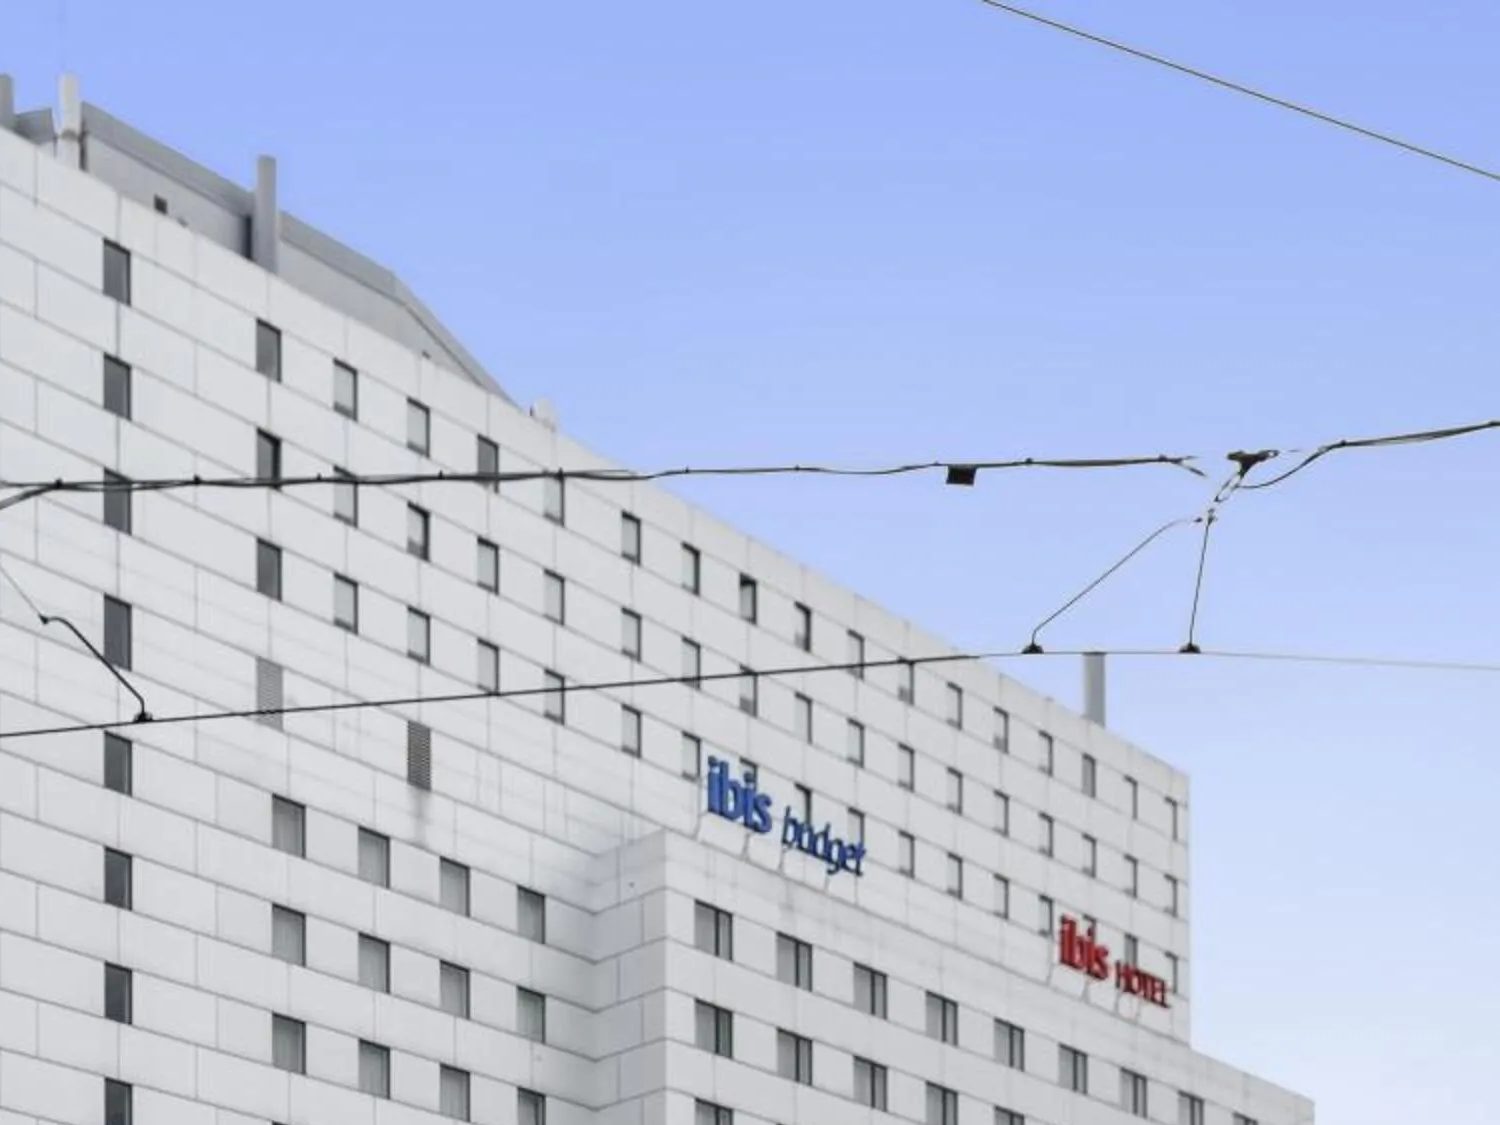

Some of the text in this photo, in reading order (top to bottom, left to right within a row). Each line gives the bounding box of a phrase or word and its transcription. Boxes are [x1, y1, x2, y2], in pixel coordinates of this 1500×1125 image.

[707, 754, 867, 877] ibis budget
[1059, 913, 1172, 1009] ibis HOTEL
